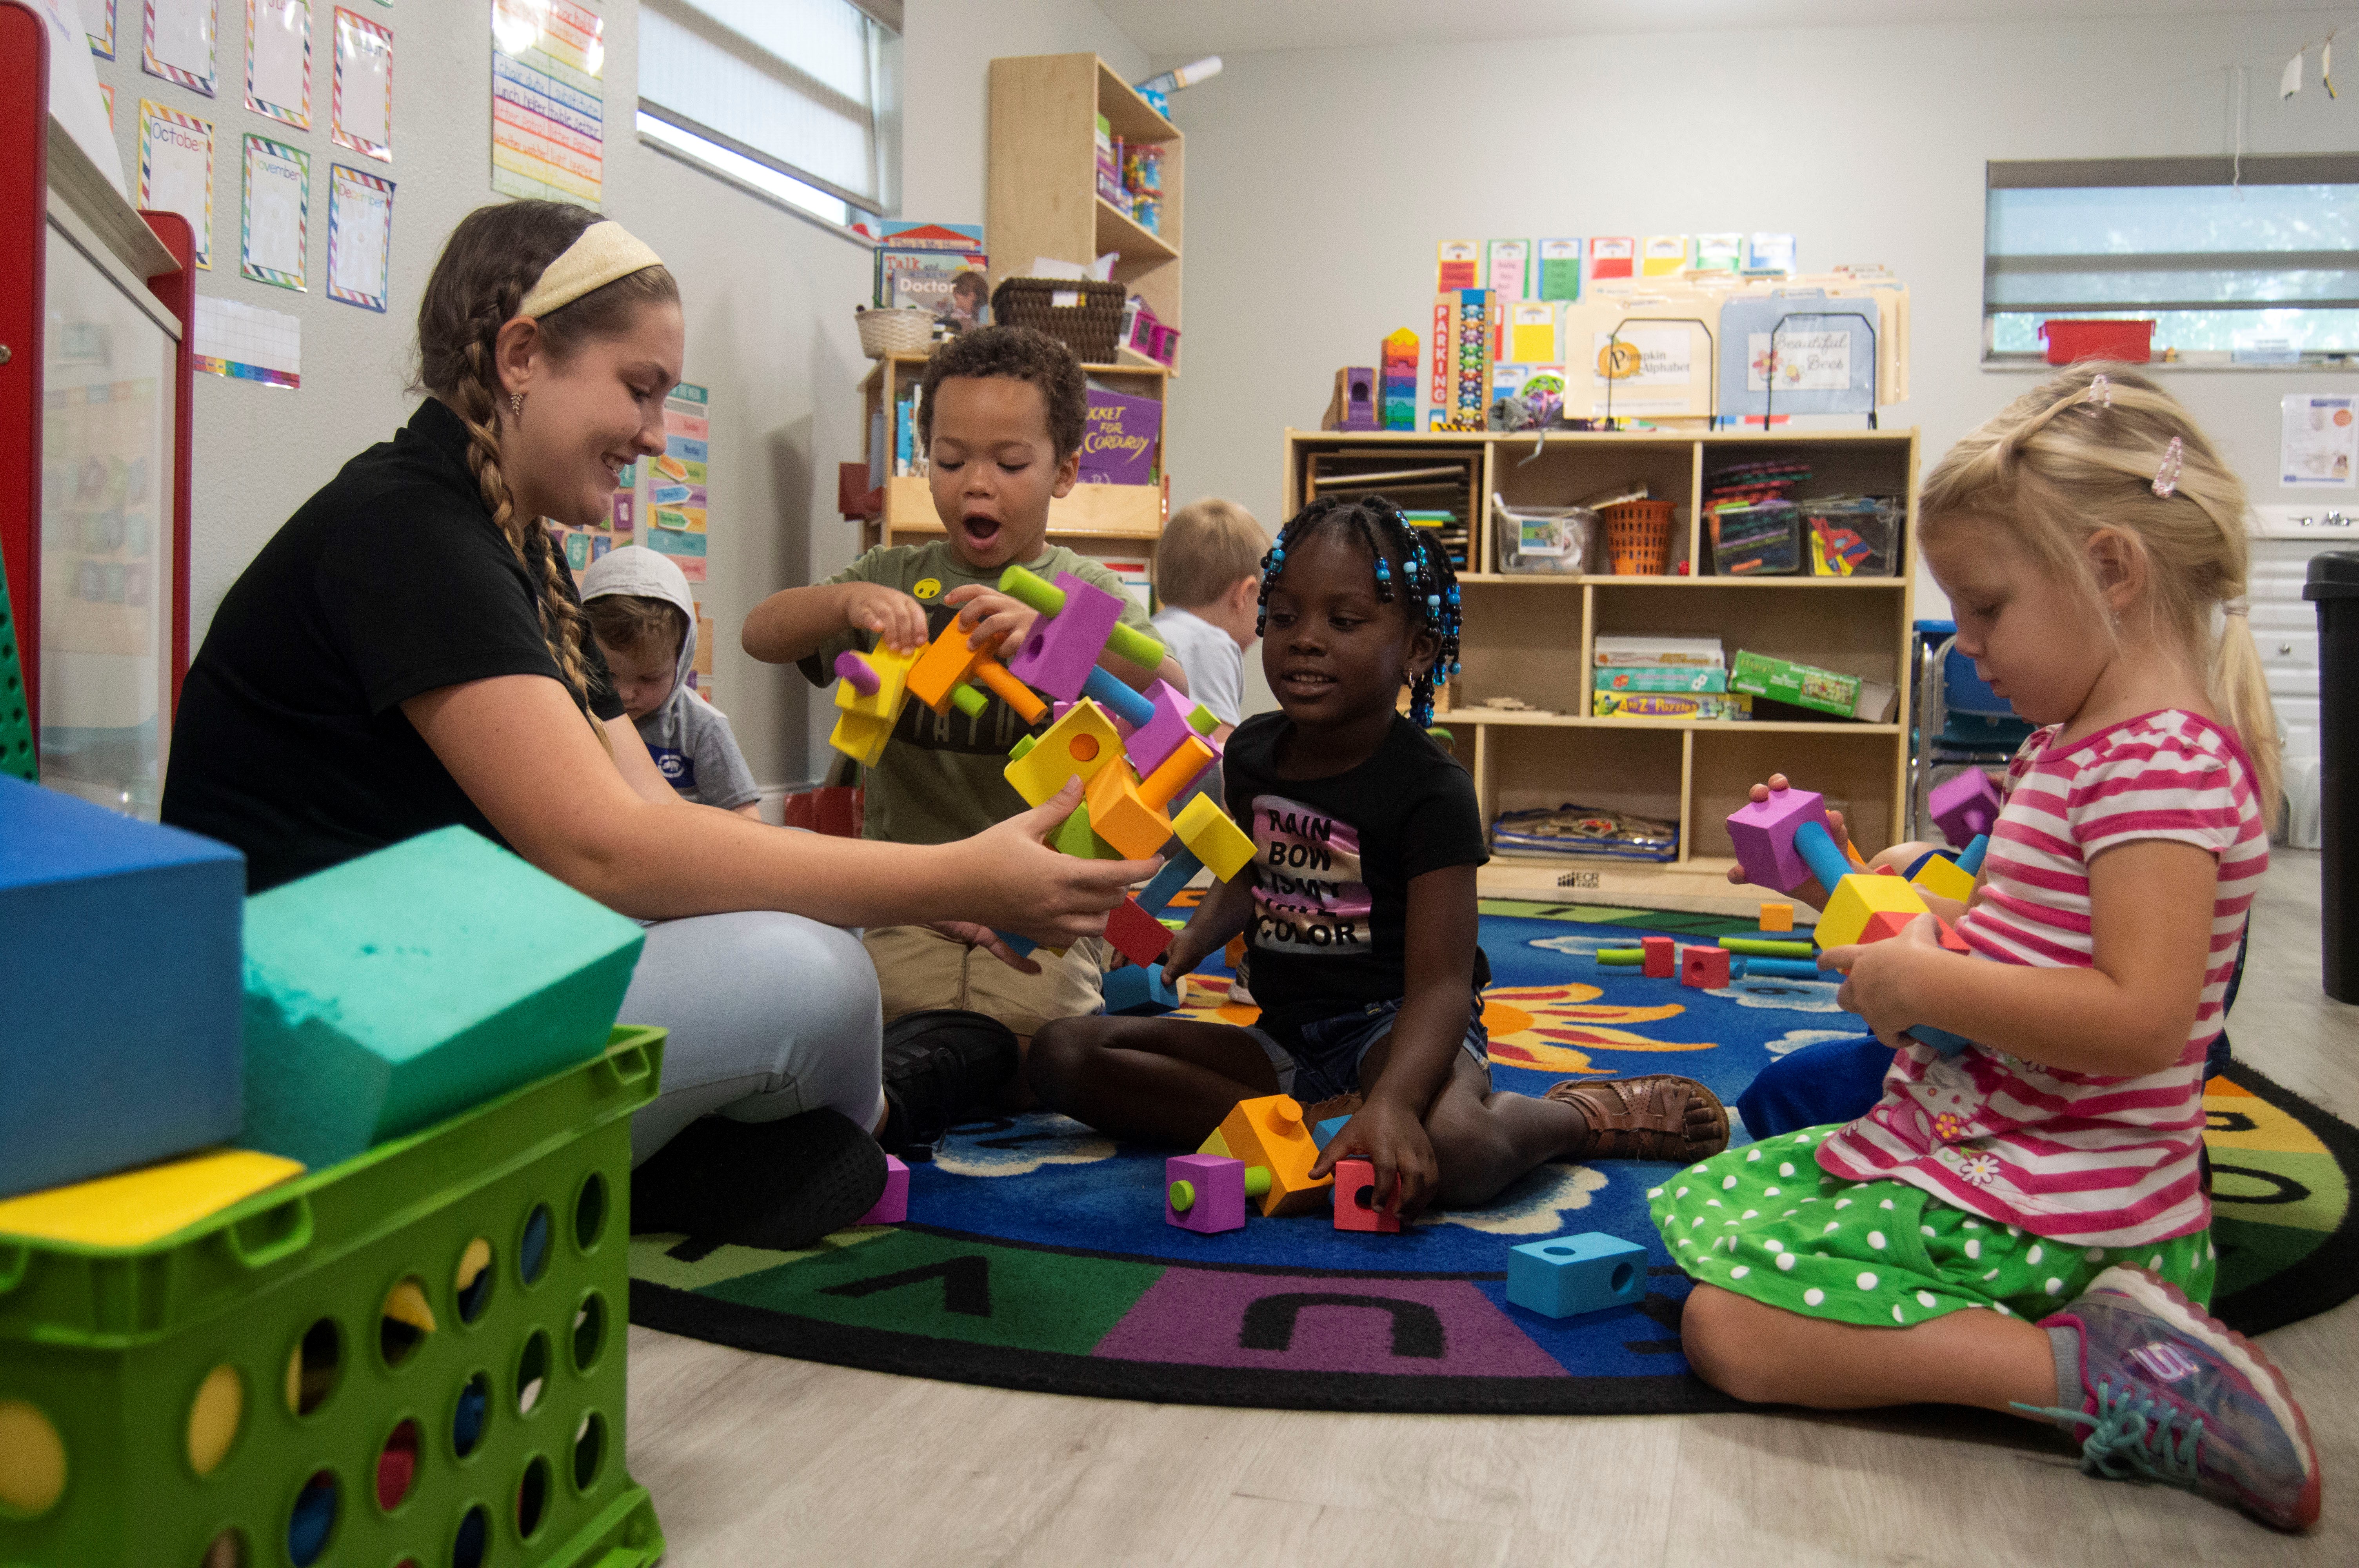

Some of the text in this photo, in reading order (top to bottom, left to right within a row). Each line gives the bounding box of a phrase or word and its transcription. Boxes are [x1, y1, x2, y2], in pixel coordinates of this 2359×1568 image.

[153, 122, 206, 153] October
[253, 156, 301, 181] November
[339, 183, 385, 209] December
[885, 256, 920, 270] Talk
[900, 278, 957, 293] Doctor
[1434, 306, 1447, 401] PARKING
[1775, 334, 1848, 354] Beautiful
[1612, 349, 1666, 369] Pumpkin
[1644, 363, 1689, 373] Alphabet
[1807, 354, 1843, 370] Bees
[1100, 421, 1124, 434] FOR
[1639, 698, 1648, 712] Z
[1655, 698, 1699, 713] Puzzles
[1268, 809, 1332, 842] RAIN
[1269, 841, 1331, 871] BOW
[1576, 873, 1599, 882] ECR
[1272, 874, 1341, 903] IS MY
[1256, 915, 1359, 946] COLOR
